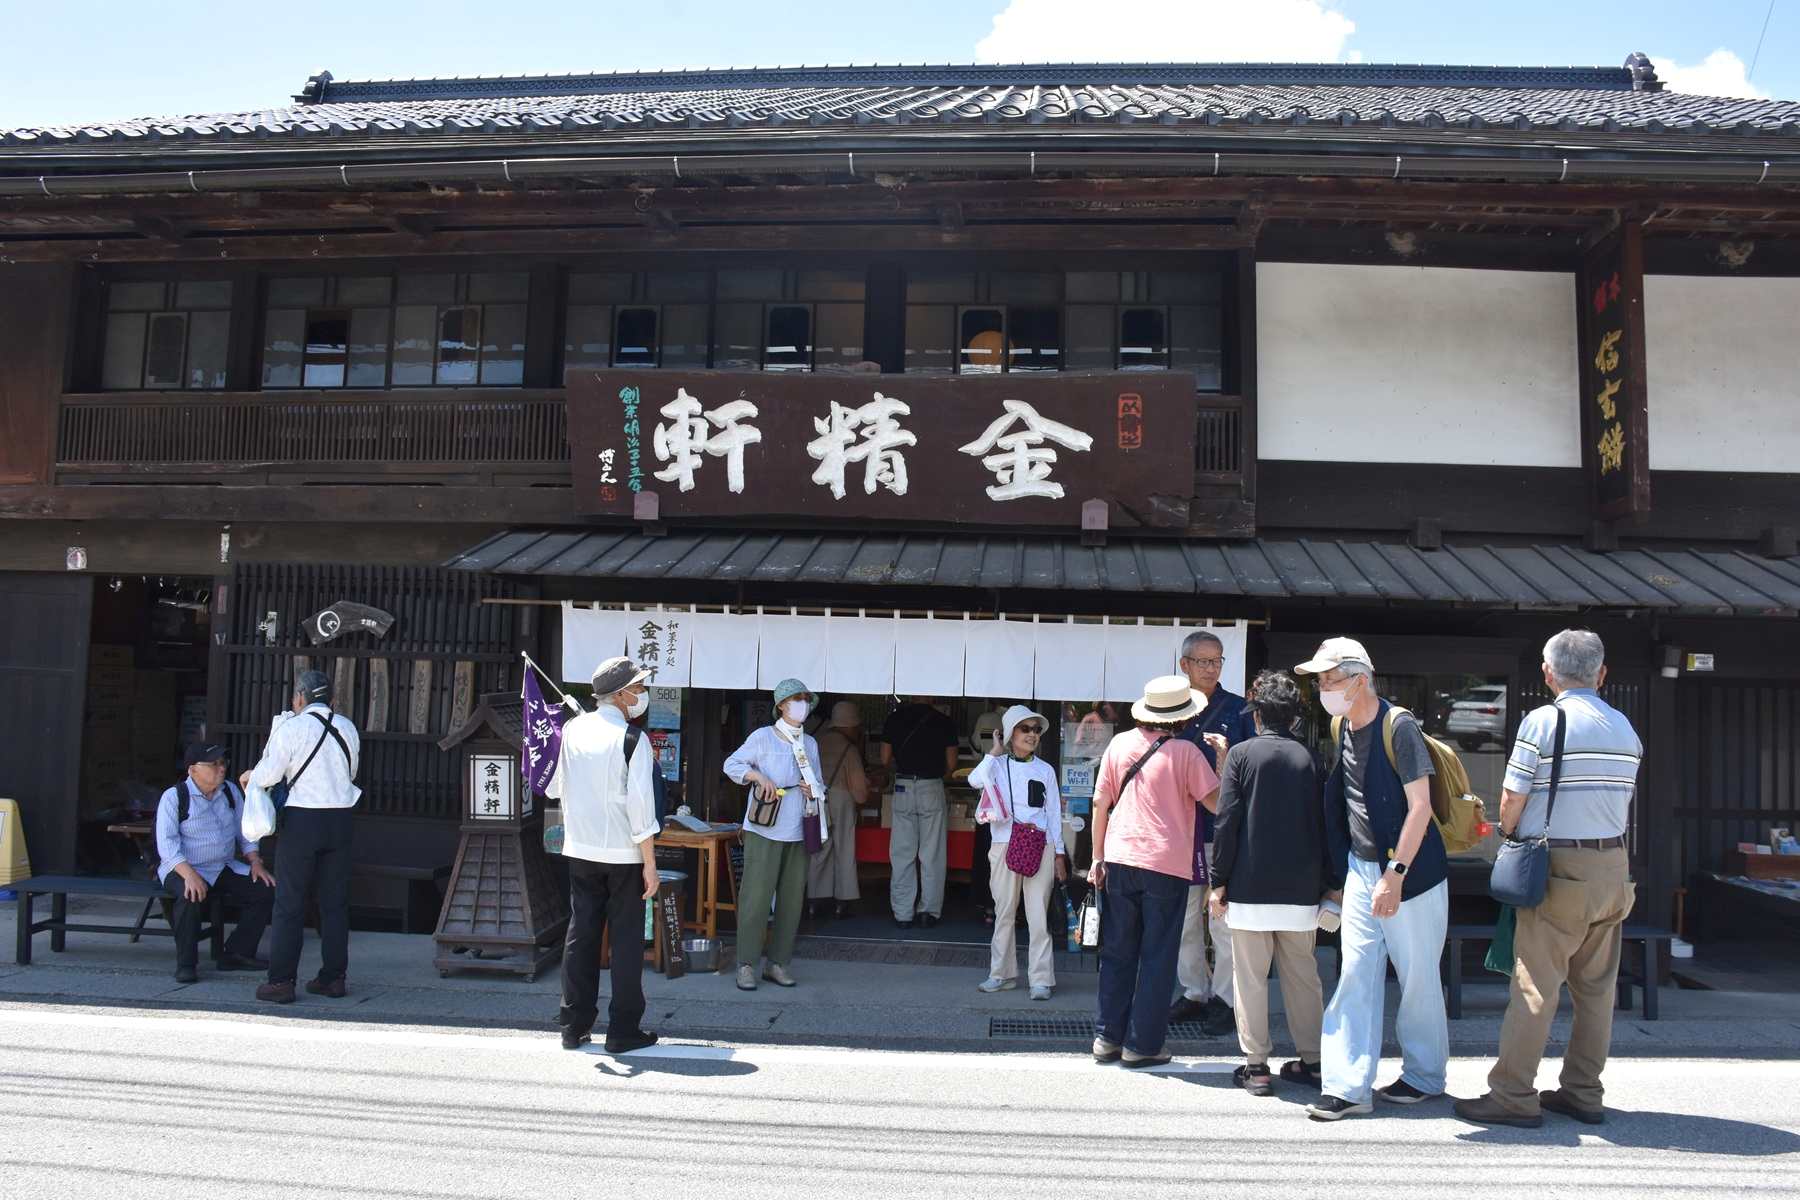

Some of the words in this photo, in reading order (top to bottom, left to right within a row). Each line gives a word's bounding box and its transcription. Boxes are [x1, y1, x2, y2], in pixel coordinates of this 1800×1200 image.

[665, 619, 680, 667] 和菓子処
[483, 761, 502, 814] 金精軒
[1067, 768, 1089, 778] Free
[1067, 777, 1089, 786] Wi-Fi
